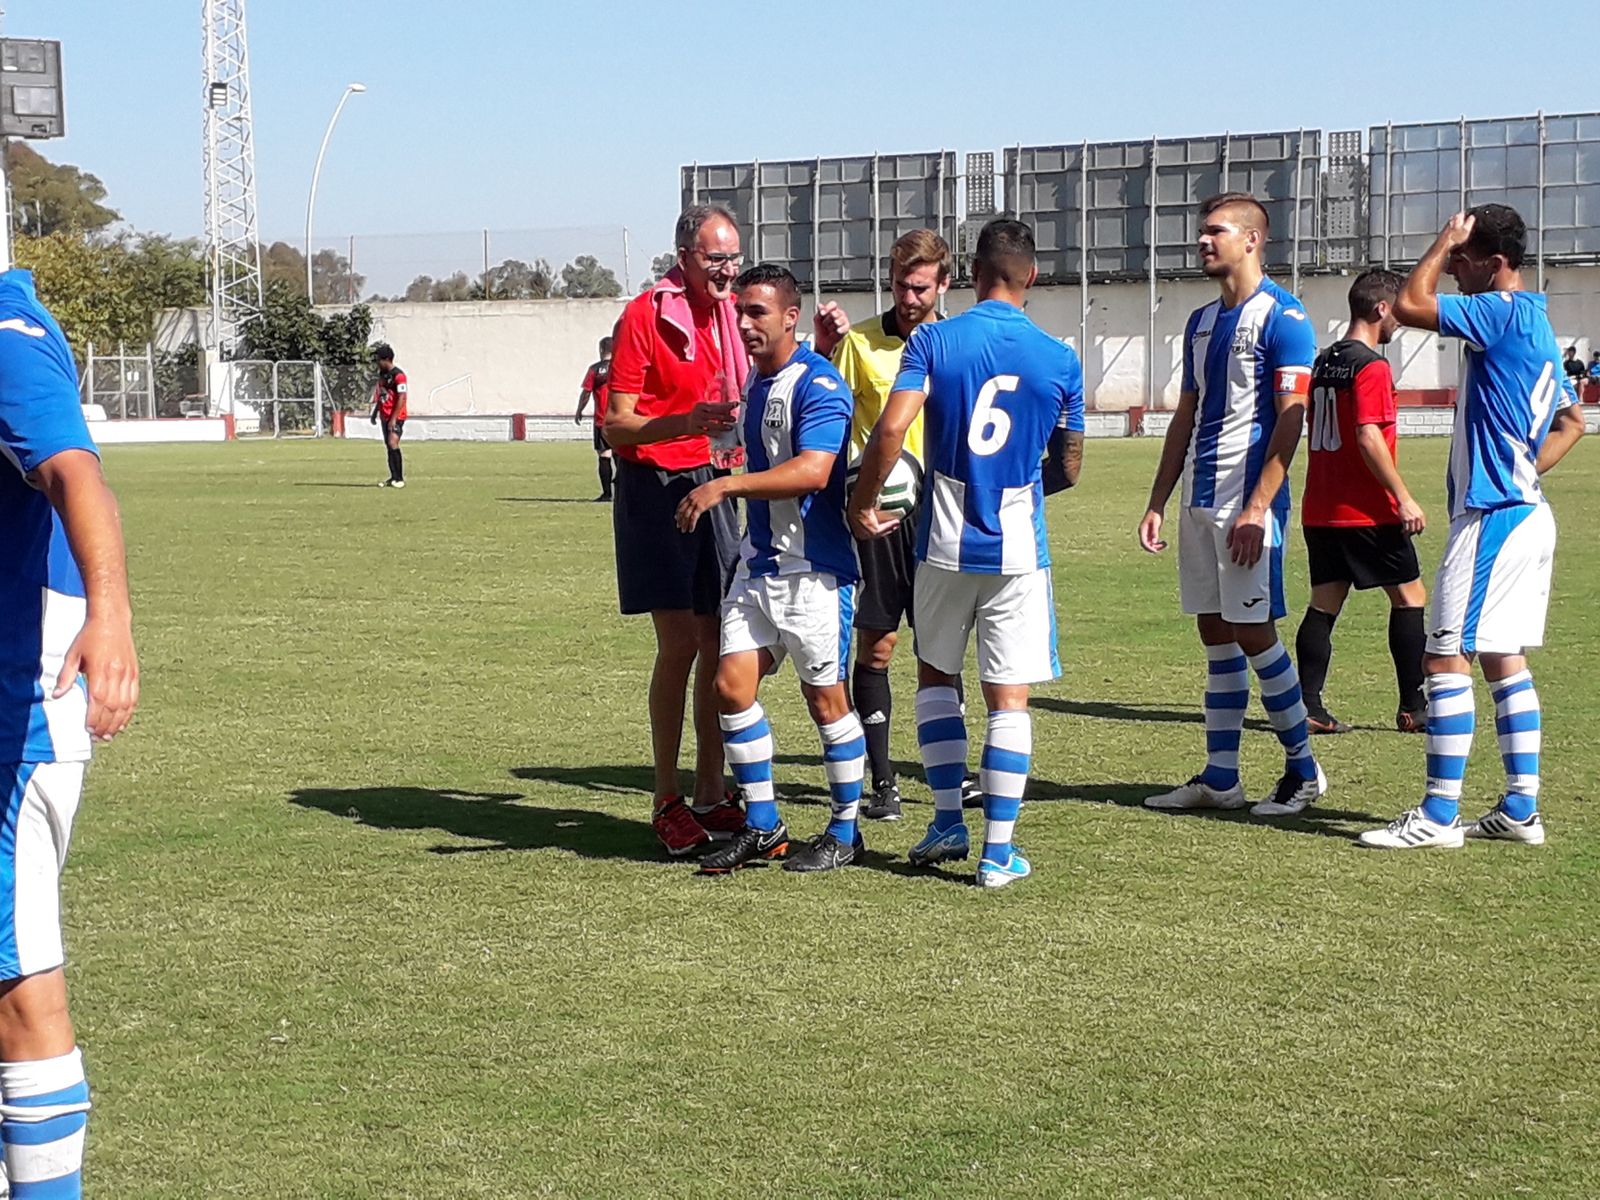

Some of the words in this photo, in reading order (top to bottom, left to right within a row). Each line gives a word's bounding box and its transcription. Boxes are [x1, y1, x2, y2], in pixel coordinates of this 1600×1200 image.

[967, 375, 1020, 456] 6
[1310, 386, 1342, 452] 10
[1529, 361, 1555, 440] 4
